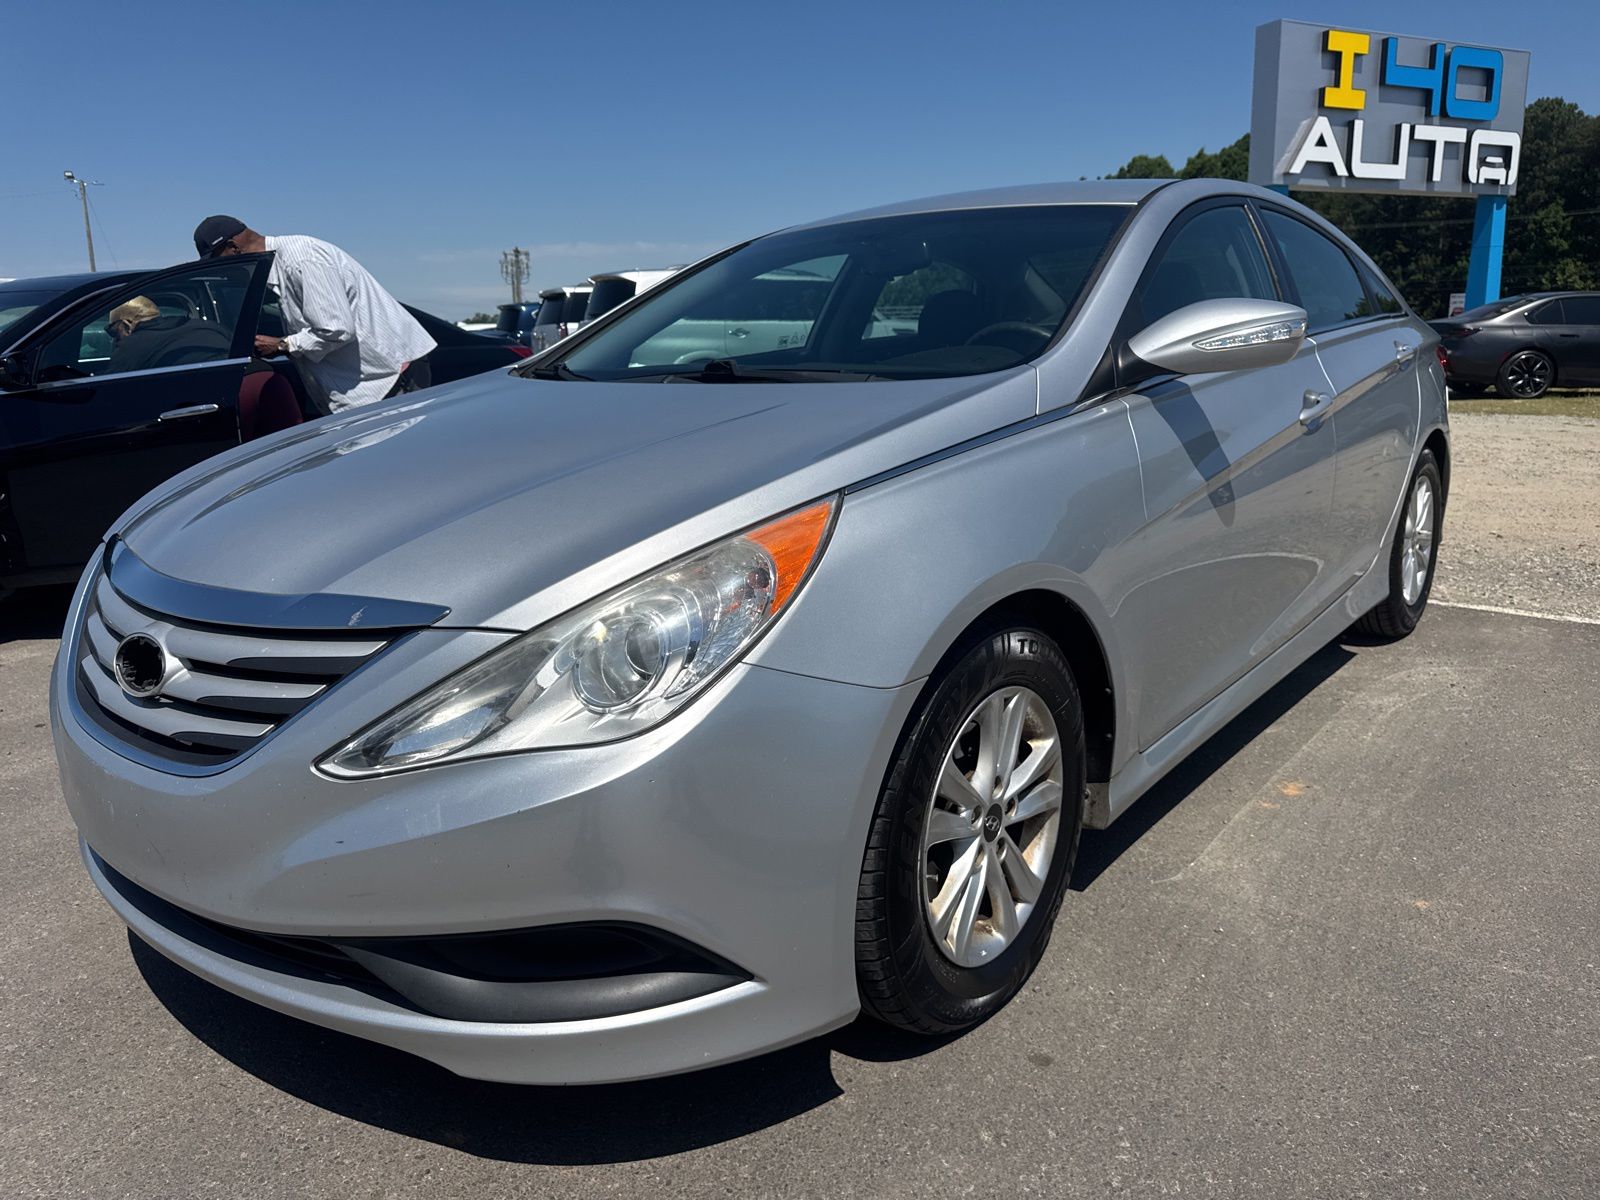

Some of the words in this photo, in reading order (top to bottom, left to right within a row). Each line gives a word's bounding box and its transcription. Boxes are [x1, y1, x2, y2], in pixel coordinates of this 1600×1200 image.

[1322, 29, 1370, 110] I
[1382, 36, 1503, 121] 40
[1288, 116, 1521, 186] AUTO
